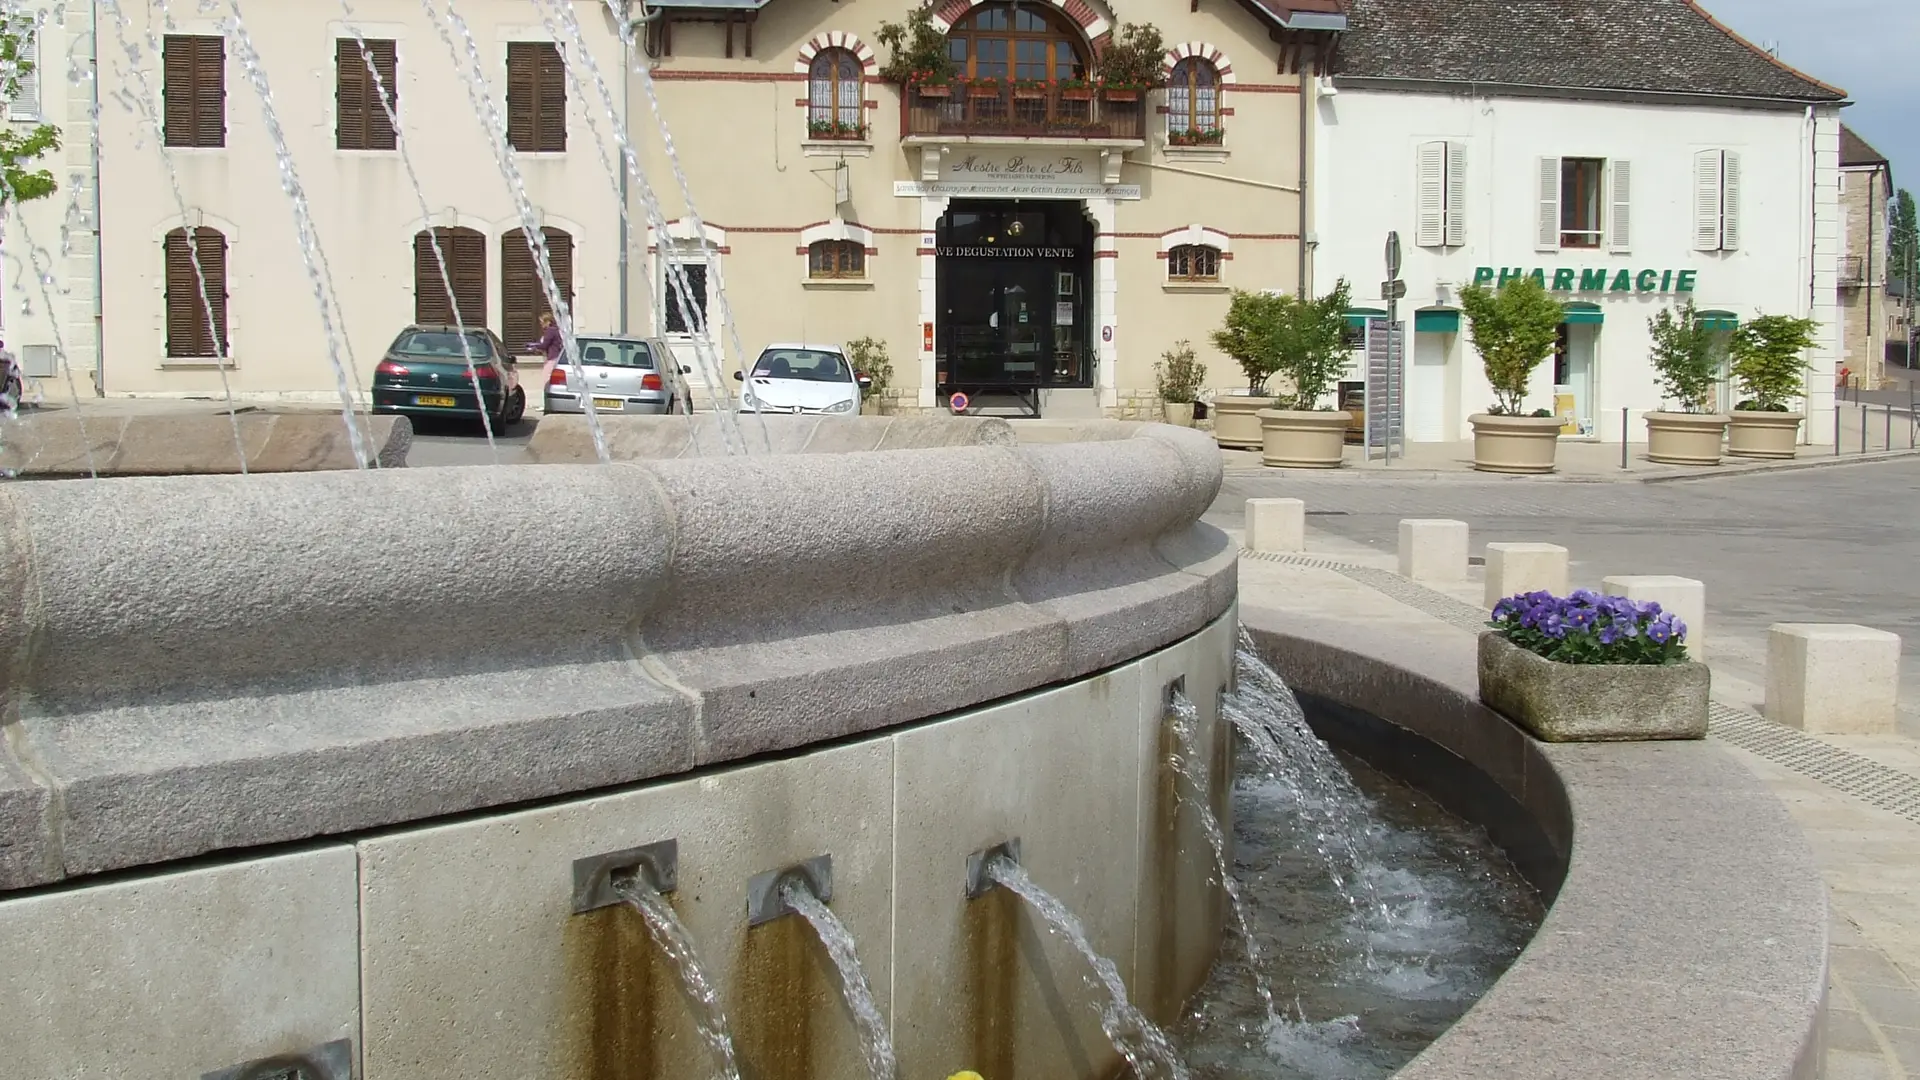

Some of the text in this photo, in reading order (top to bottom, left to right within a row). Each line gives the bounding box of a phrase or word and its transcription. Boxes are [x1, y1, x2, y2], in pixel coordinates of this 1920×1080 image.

[1040, 163, 1053, 173] et
[1055, 156, 1084, 174] Fils
[956, 247, 1034, 257] DEGUSTATION
[1036, 248, 1074, 258] VENTE
[1472, 267, 1697, 292] PHARMACIE
